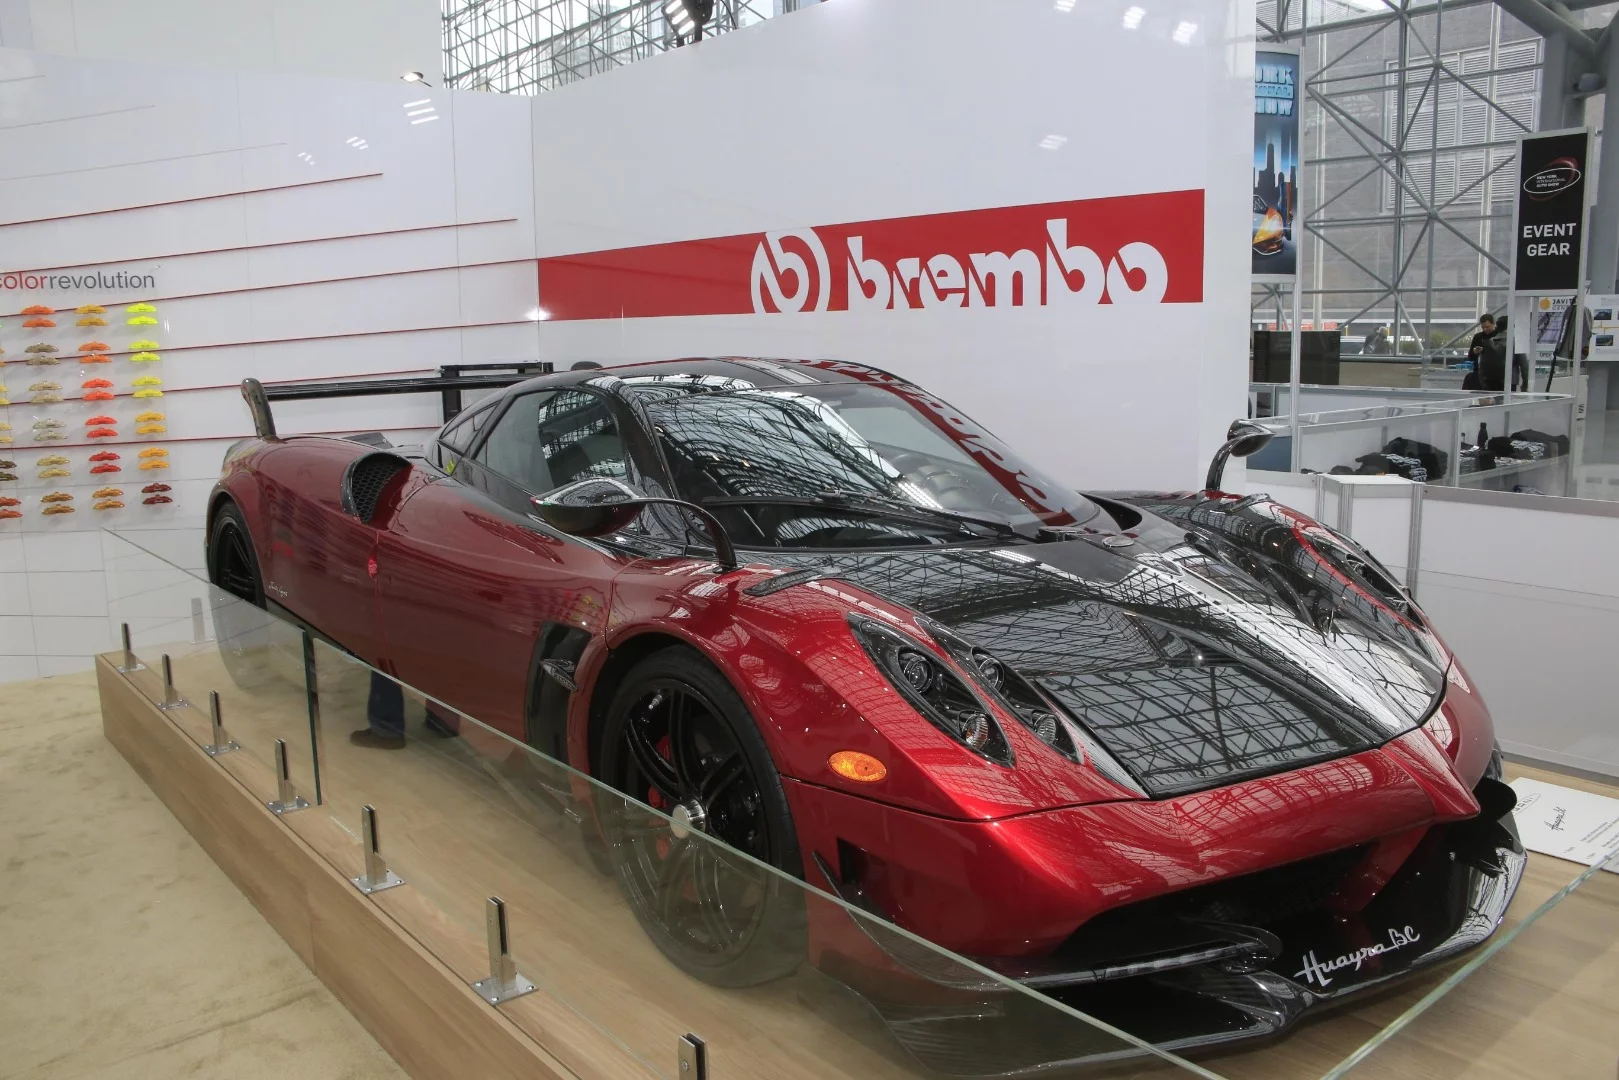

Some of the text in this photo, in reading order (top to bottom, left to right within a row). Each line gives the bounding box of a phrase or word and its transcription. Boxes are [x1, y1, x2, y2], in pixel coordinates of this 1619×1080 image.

[1523, 222, 1577, 238] EVENT
[847, 218, 1168, 309] brembo
[1526, 242, 1571, 257] GEAR
[1294, 925, 1420, 986] Huayra BC
